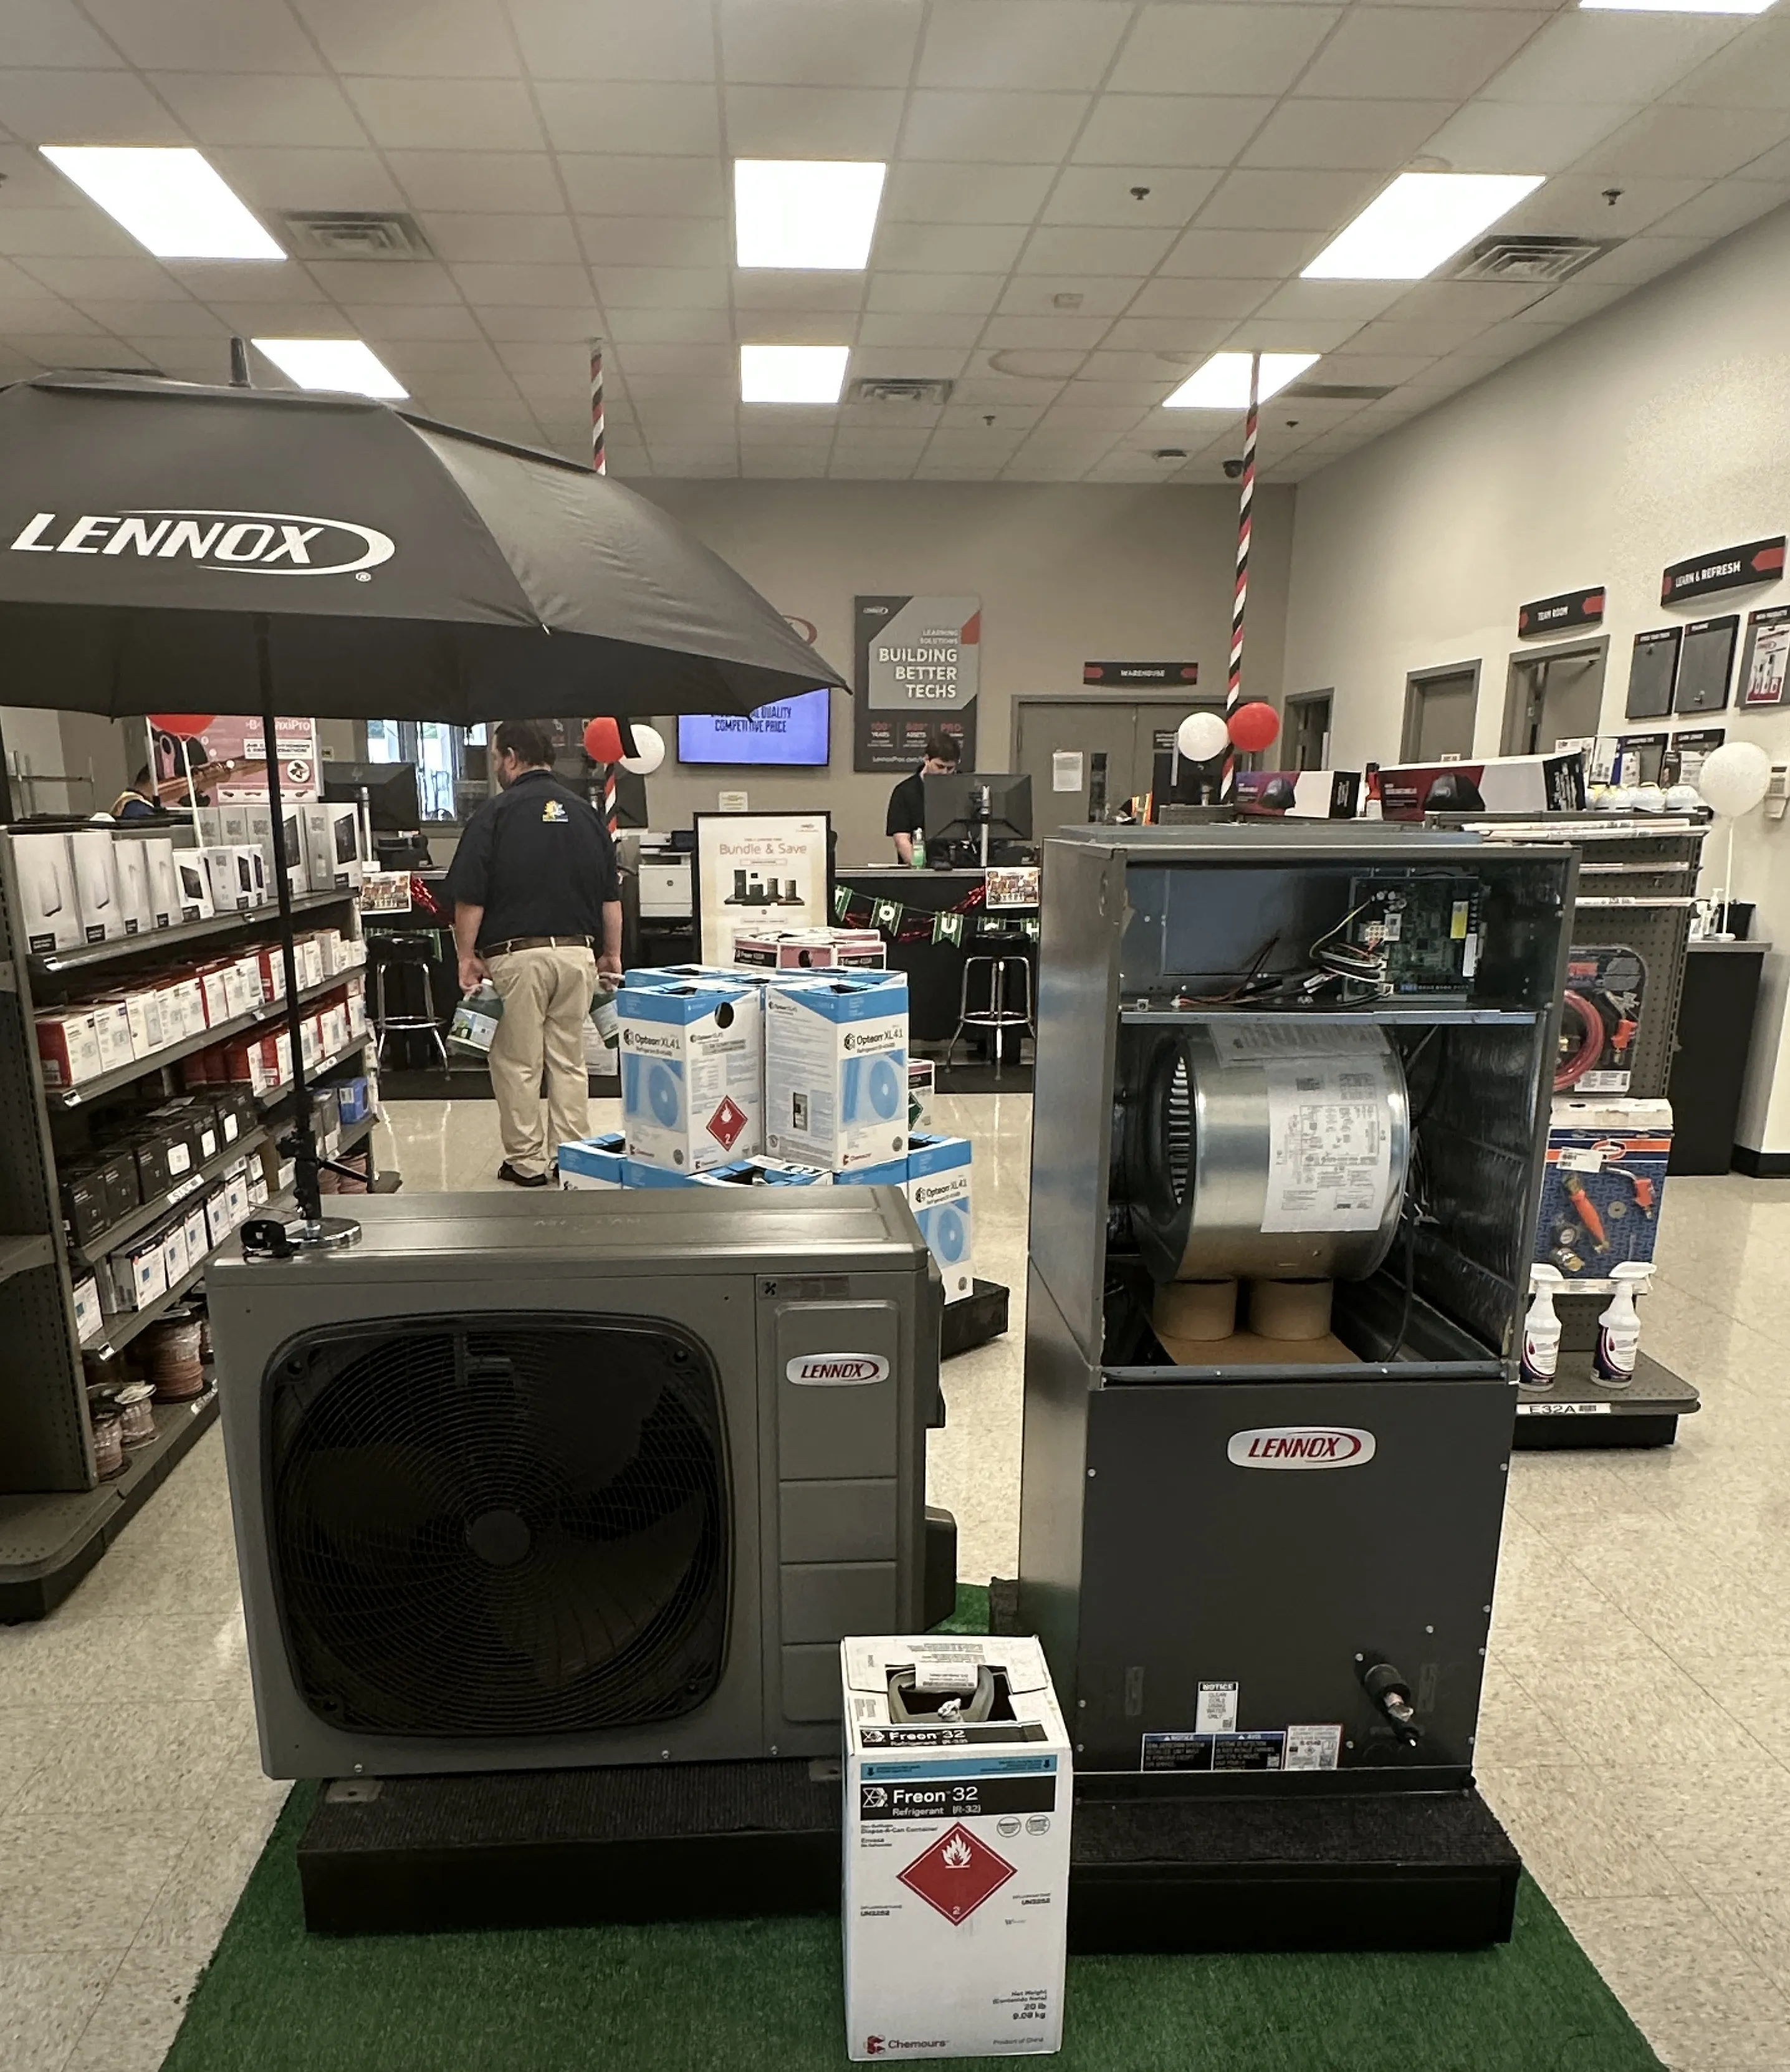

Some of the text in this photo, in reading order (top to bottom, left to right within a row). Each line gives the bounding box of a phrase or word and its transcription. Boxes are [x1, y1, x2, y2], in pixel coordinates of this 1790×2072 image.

[11, 512, 323, 564] LENNOX
[1701, 561, 1741, 580] REFRESH
[879, 648, 957, 662] BUILDING
[896, 666, 957, 680] BETTER
[906, 684, 956, 698] TECHS
[762, 706, 791, 718] QUALITY
[715, 719, 786, 732] COMPETITIVE PRICE
[720, 843, 806, 855] Bundle & Save
[724, 1134, 731, 1144] 2
[801, 1363, 864, 1379] LENNOX
[1248, 1437, 1340, 1457] LENNOX
[889, 1730, 966, 1740] Freon 32
[893, 1786, 979, 1804] Freon 32
[893, 1807, 944, 1816] Refrigerant
[952, 1906, 960, 1915] 2
[1035, 2012, 1046, 2020] kg
[888, 2040, 946, 2049] Chemours
